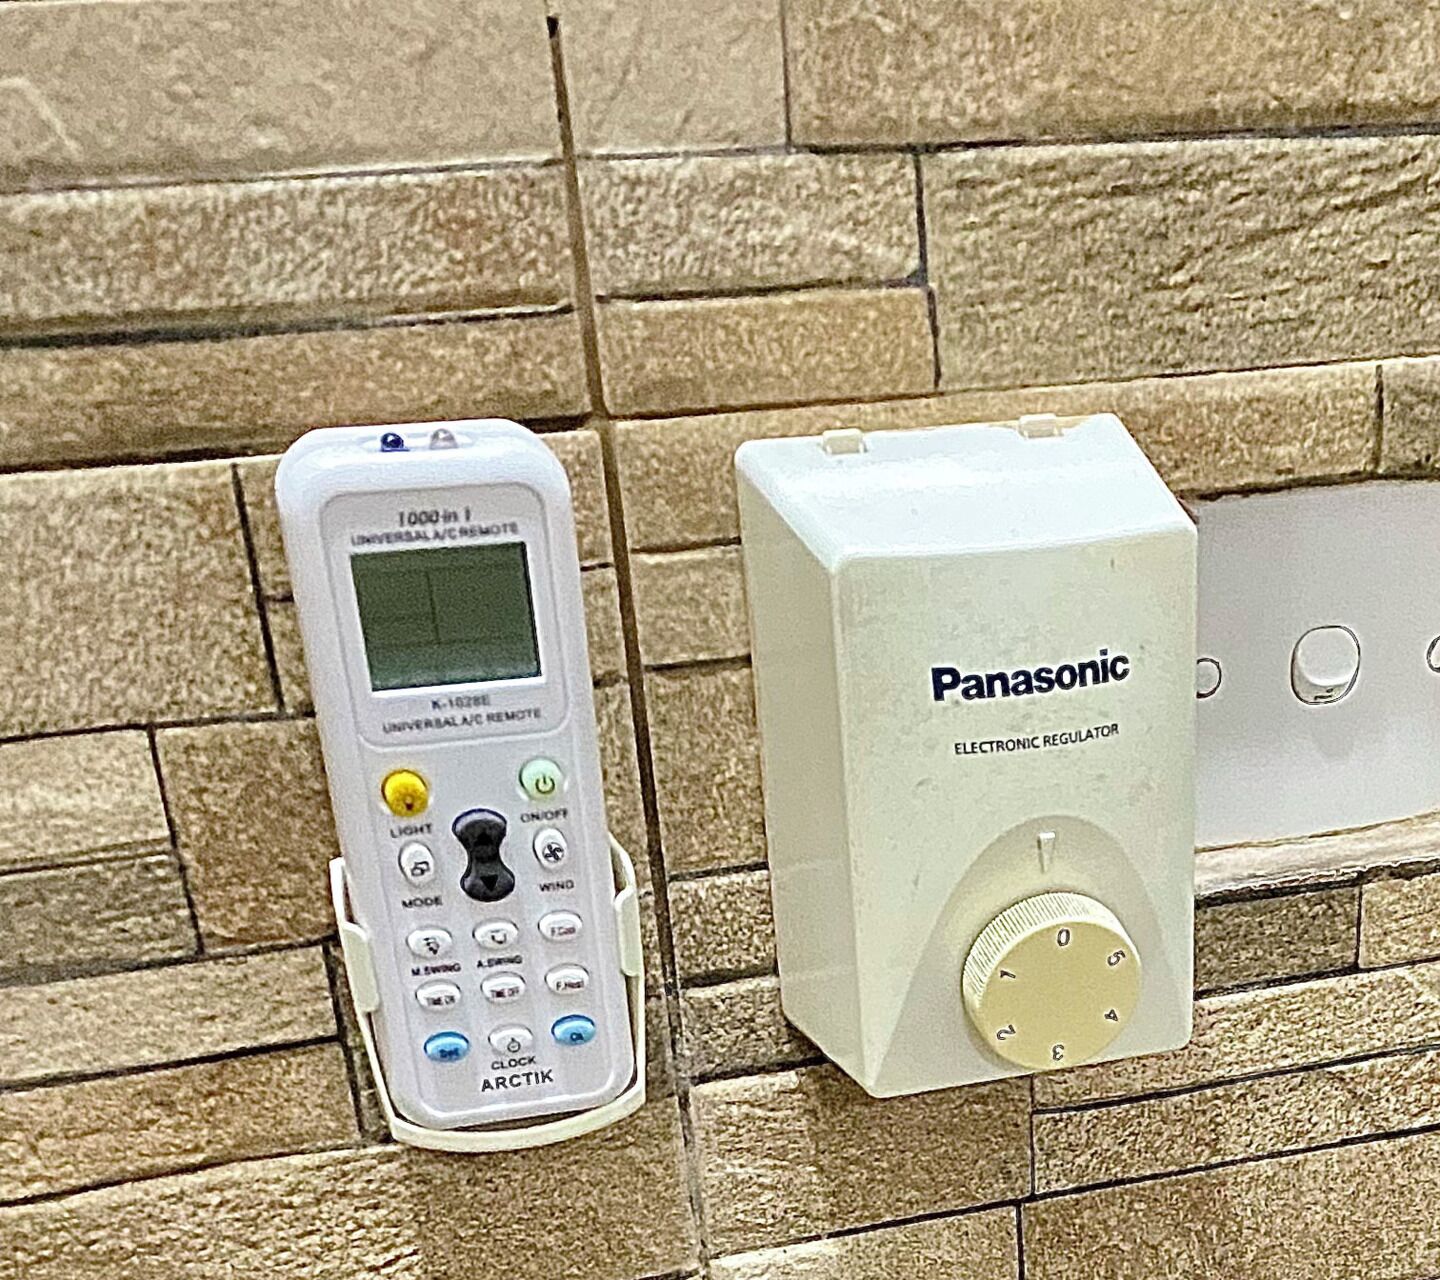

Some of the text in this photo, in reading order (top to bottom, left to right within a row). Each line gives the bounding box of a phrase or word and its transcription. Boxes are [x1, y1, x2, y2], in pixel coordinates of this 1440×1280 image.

[351, 521, 519, 546] UNIVERSAL A/C REMOTE
[931, 648, 1130, 701] Panasonic
[382, 707, 542, 734] UNIVERSAL A/C REMOTE
[954, 723, 1119, 755] ELECTRONIC REGULATOR
[520, 808, 569, 823] ON/OFF
[390, 823, 433, 839] LIGHT
[539, 879, 575, 893] WIND
[401, 896, 443, 909] MODE
[1056, 928, 1072, 947] 0
[476, 955, 523, 969] A.SWING
[1106, 950, 1126, 967] 5
[411, 962, 462, 977] M.SWING
[1104, 1008, 1119, 1022] 4
[996, 1024, 1017, 1041] 2
[1052, 1044, 1065, 1061] 3
[491, 1055, 537, 1071] CLOCK
[481, 1069, 555, 1092] ARCTIK
